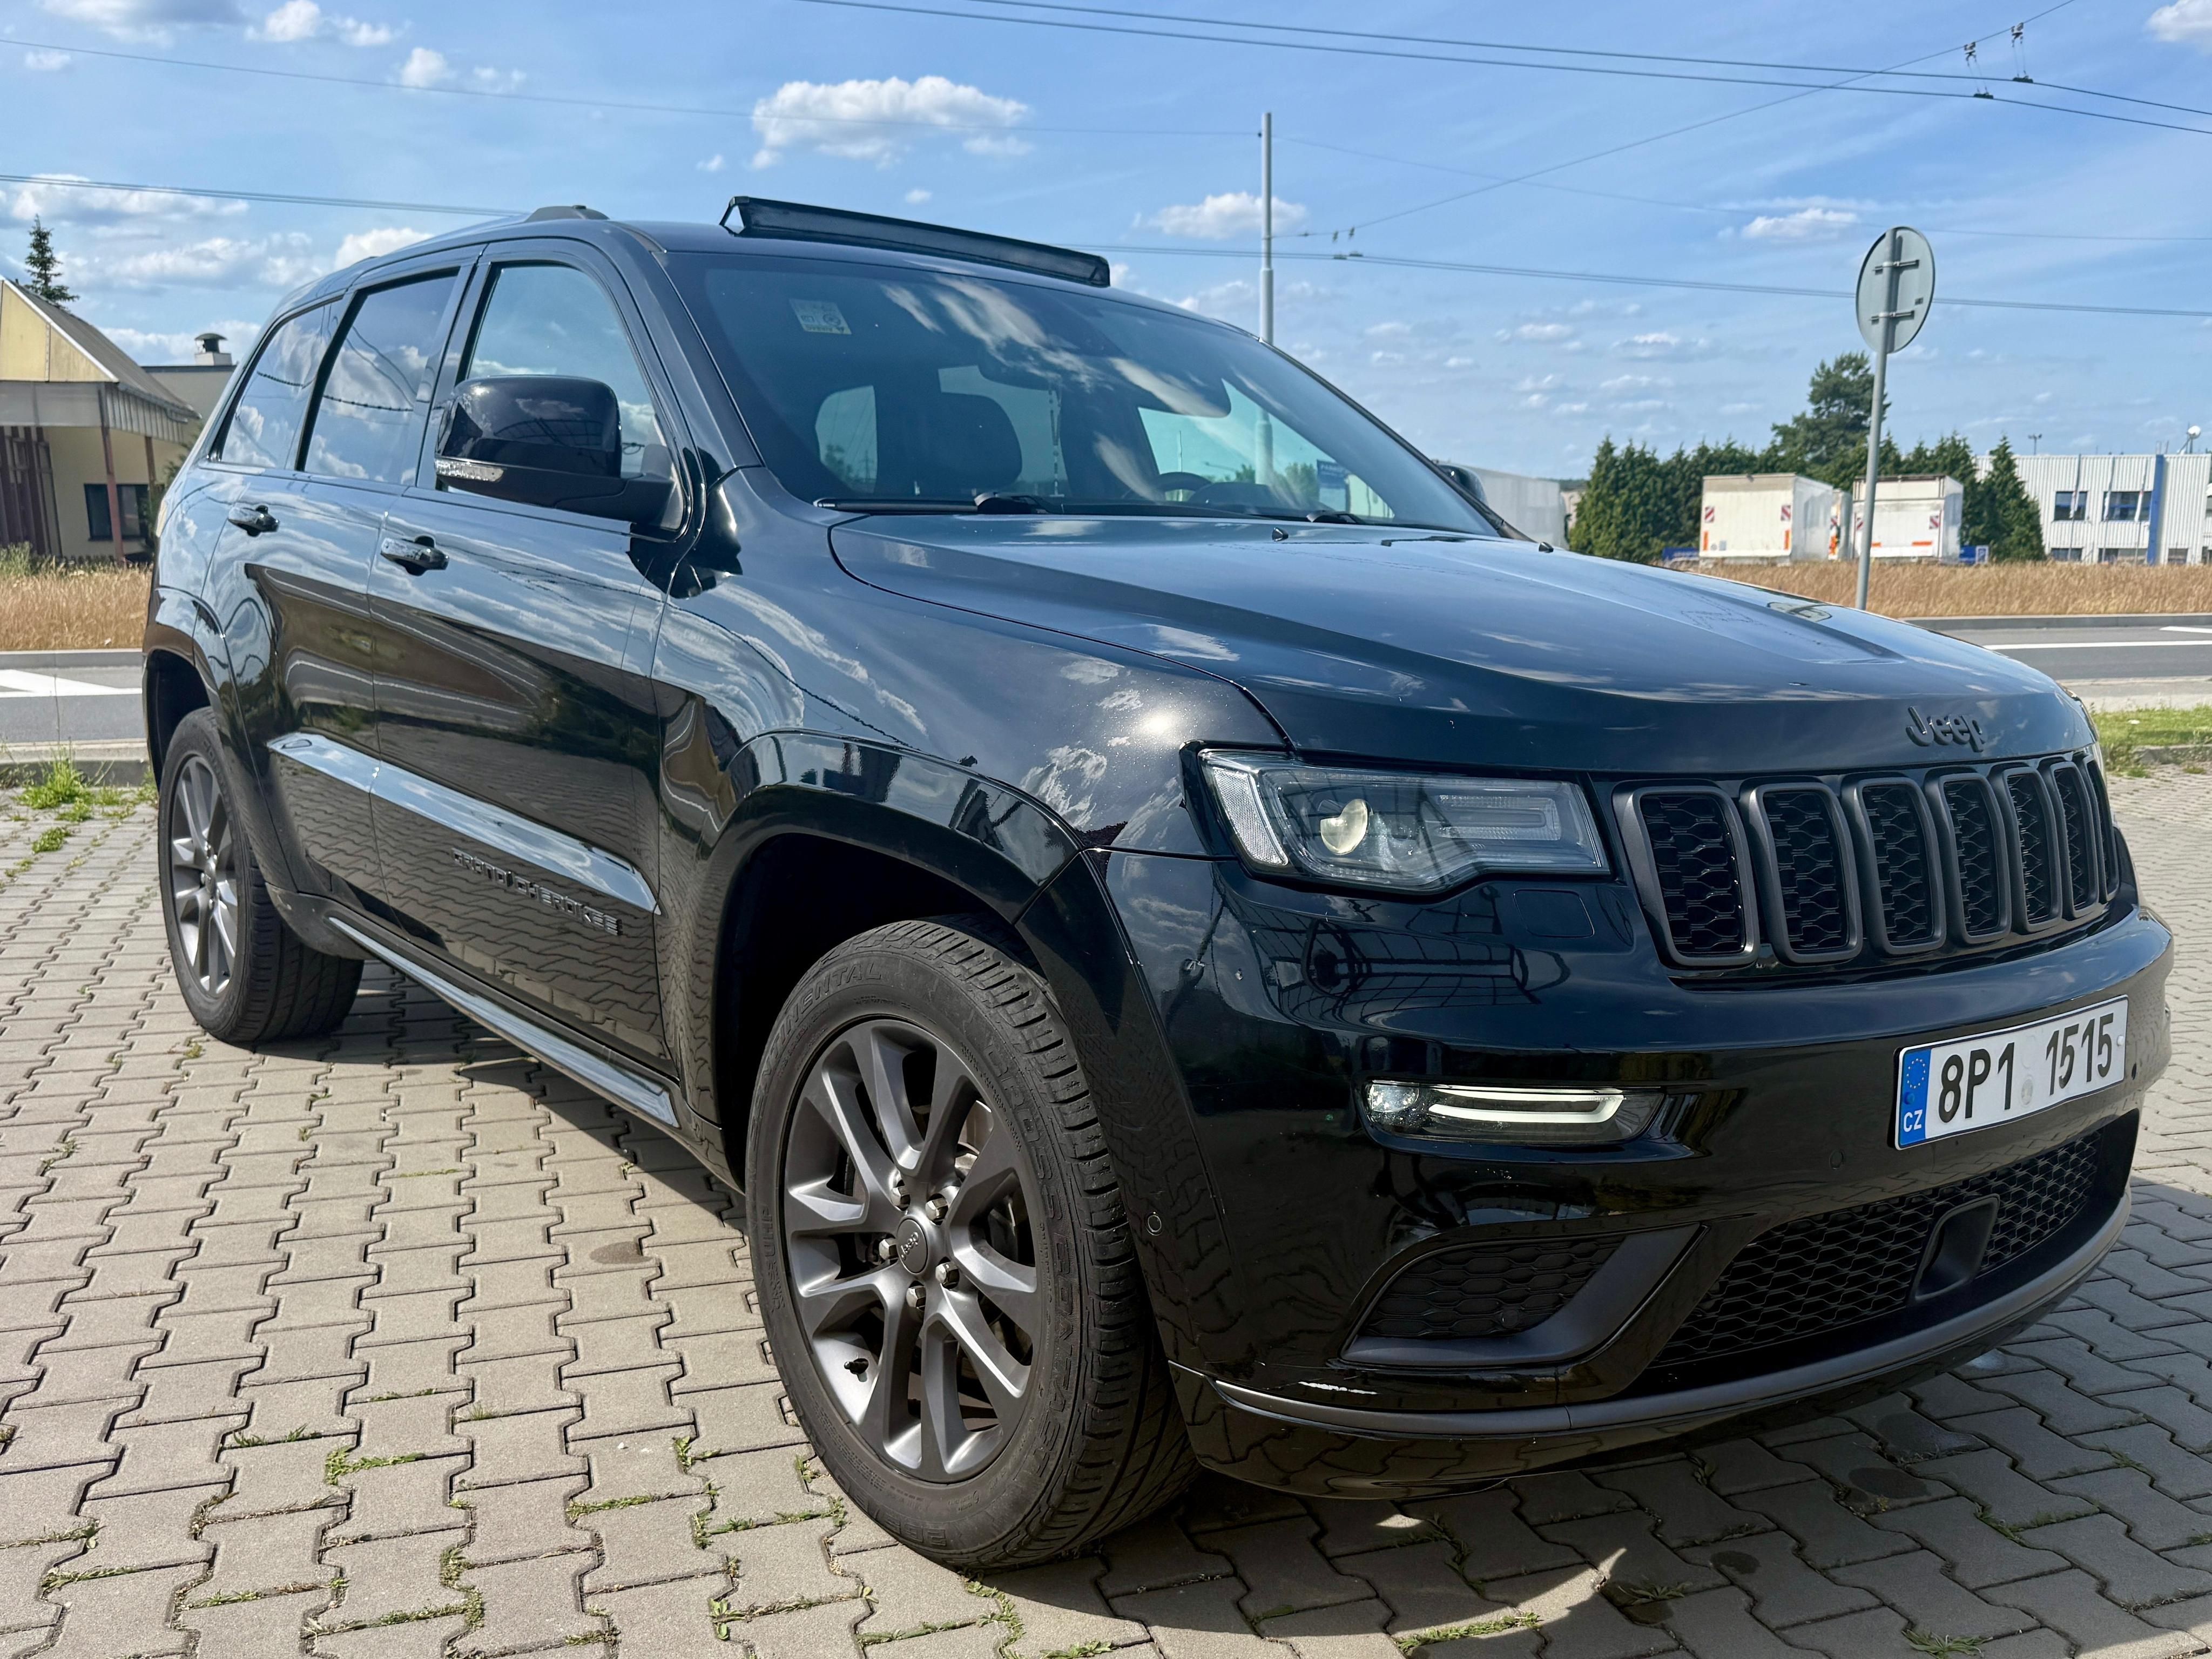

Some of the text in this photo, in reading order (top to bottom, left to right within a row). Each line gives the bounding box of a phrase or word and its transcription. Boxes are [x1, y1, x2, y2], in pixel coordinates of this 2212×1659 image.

[1905, 706, 1988, 752] Jeep
[451, 847, 623, 936] GRAND CHEROKEE
[1938, 1013, 2114, 1123] 8P1 1515
[1903, 1109, 1924, 1132] CZ
[901, 1231, 919, 1260] Jeep
